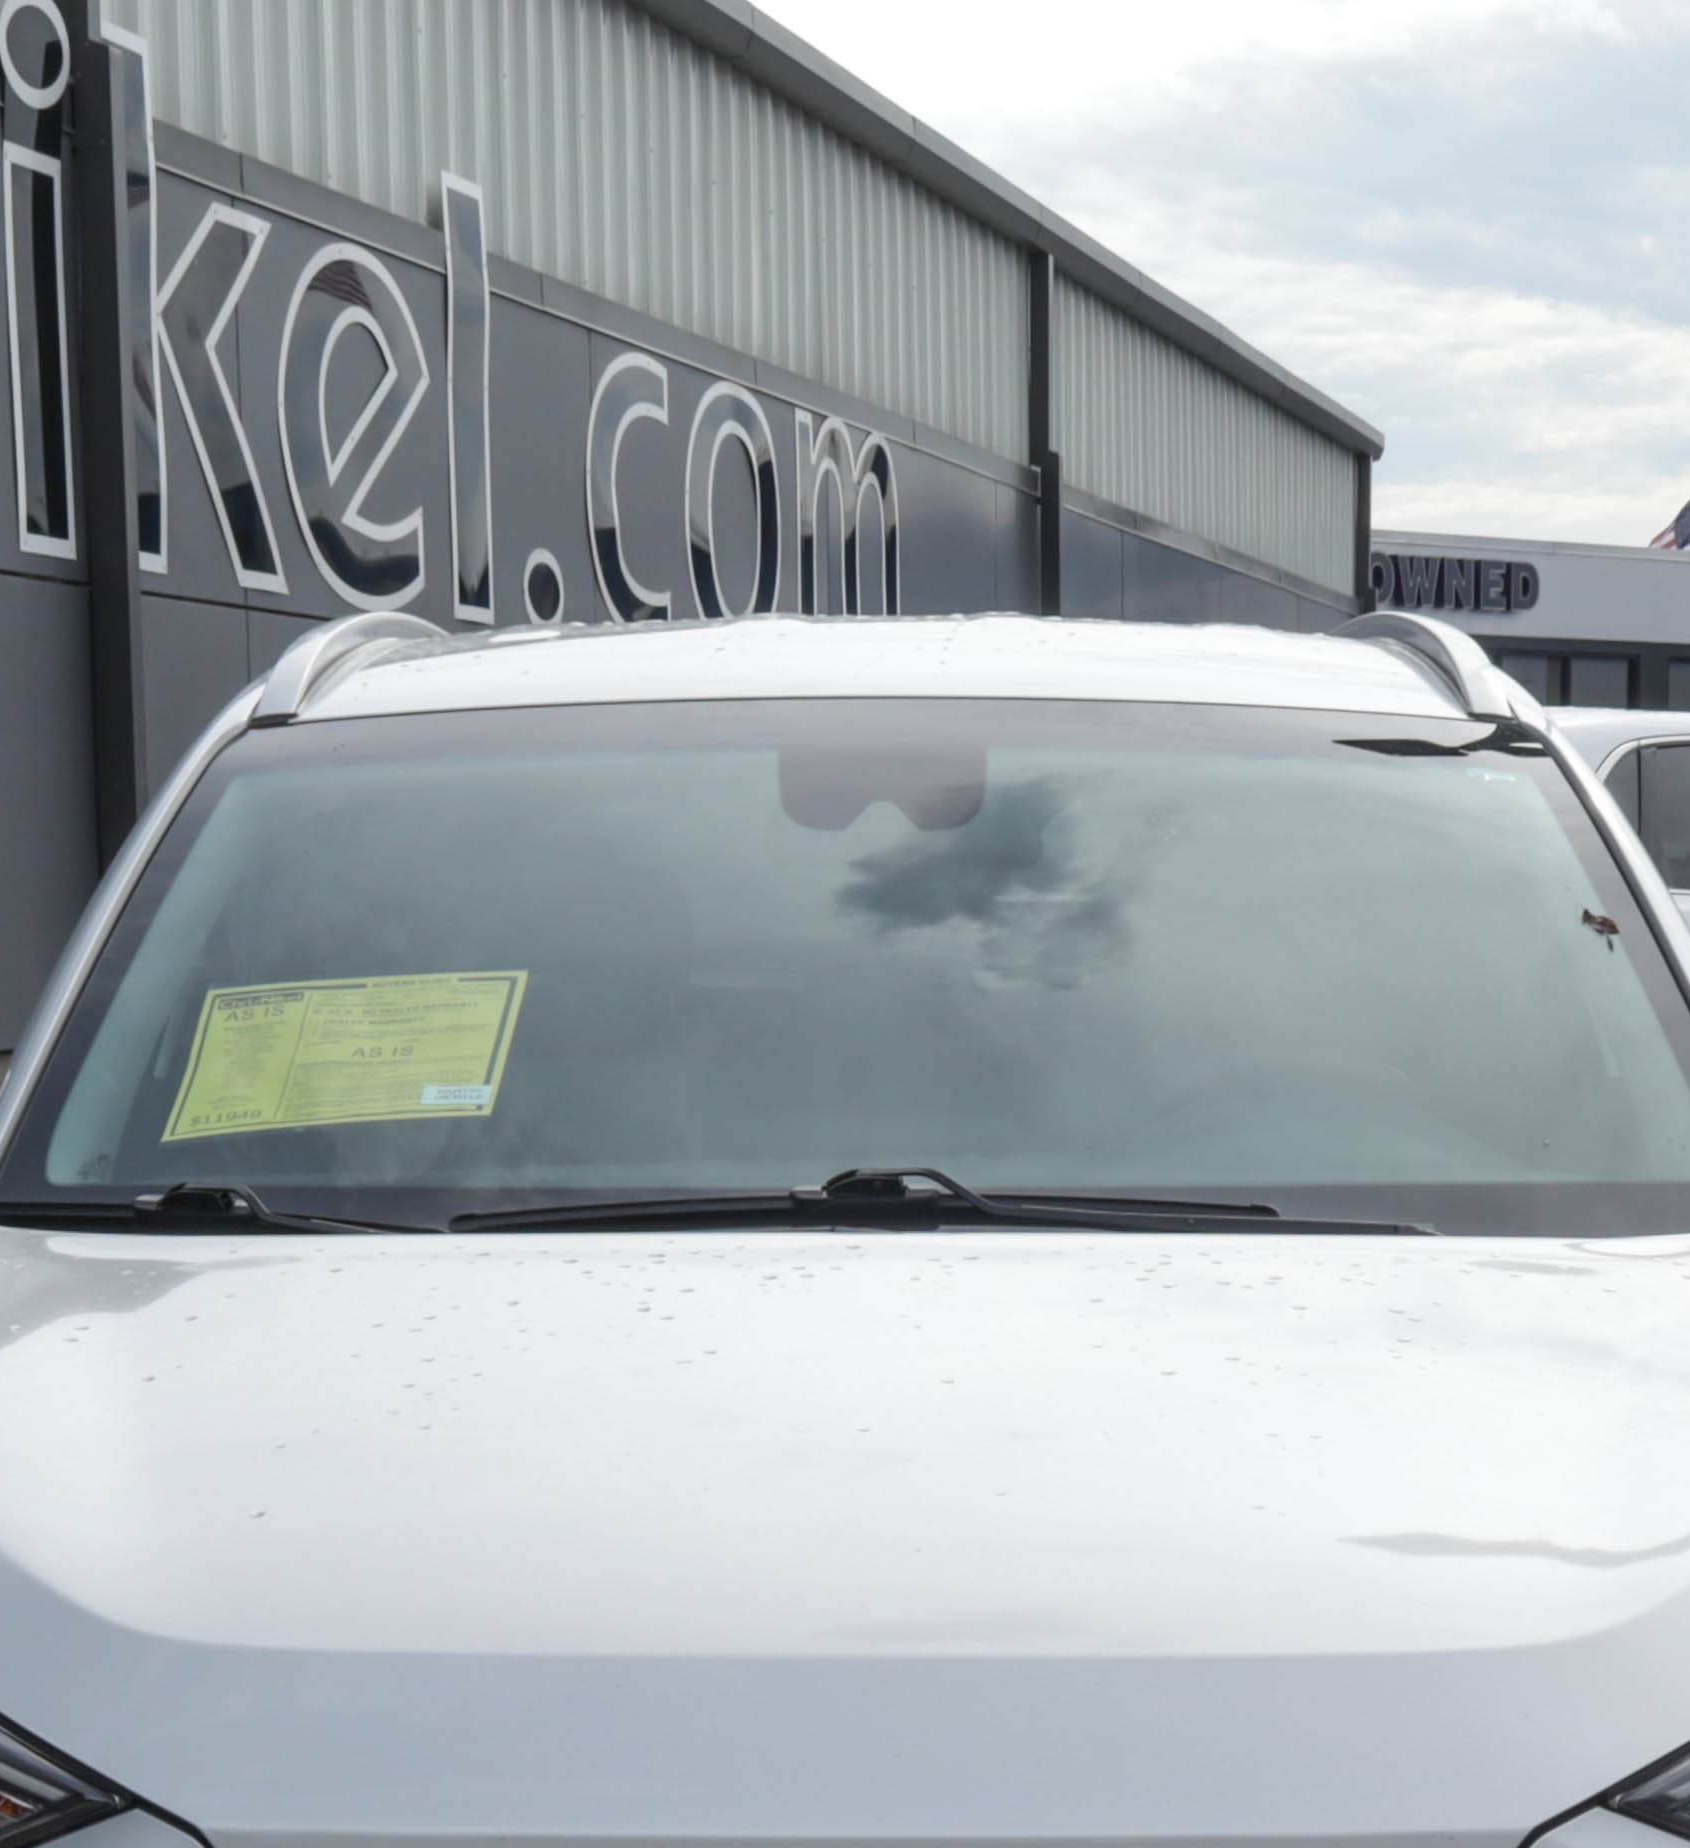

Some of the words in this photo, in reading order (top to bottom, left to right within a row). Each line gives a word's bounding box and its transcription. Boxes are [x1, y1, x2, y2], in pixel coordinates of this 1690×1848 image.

[223, 1007, 255, 1022] AS
[263, 1005, 286, 1018] IS
[351, 1047, 383, 1058] AS
[392, 1045, 415, 1057] IS
